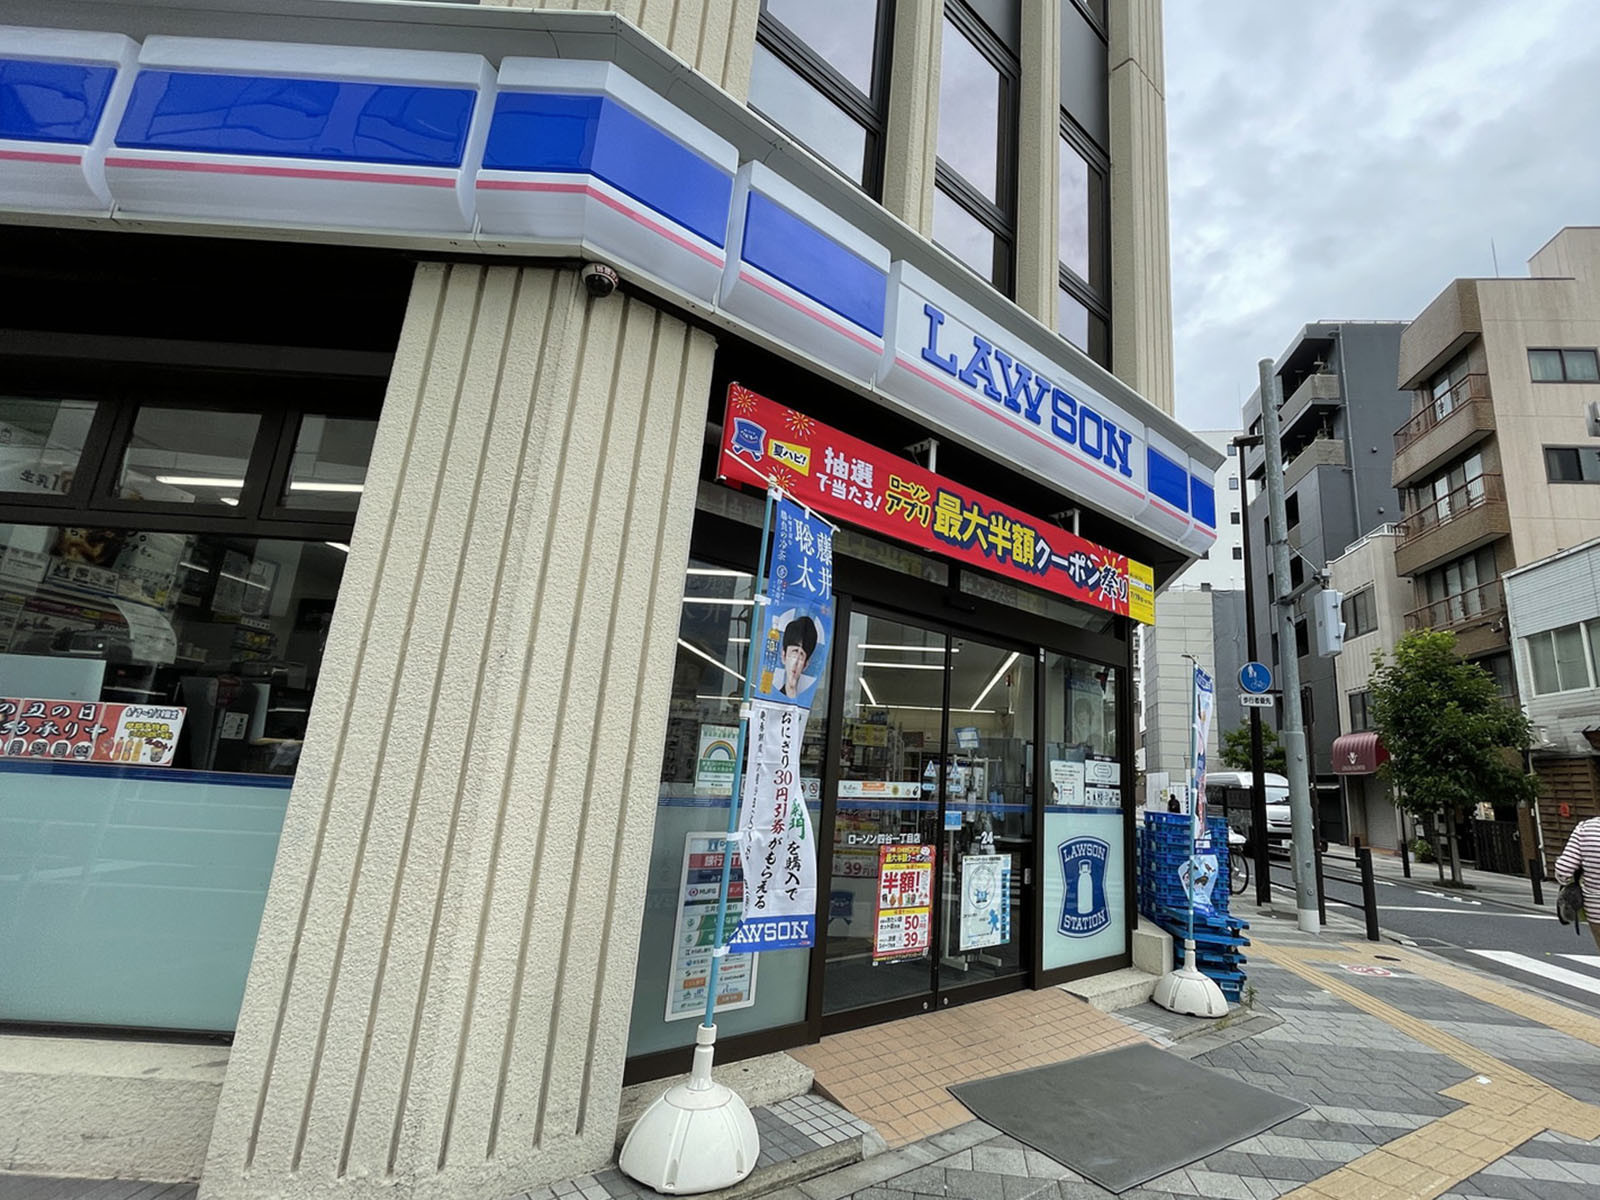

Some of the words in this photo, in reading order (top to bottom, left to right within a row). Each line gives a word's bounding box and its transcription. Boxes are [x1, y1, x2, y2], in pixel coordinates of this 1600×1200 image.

[921, 303, 1133, 478] LAWSON
[773, 442, 807, 467] 夏ハピ!
[824, 446, 874, 490] 抽選
[816, 472, 882, 512] で当たる!
[889, 475, 931, 500] ローソン
[886, 493, 931, 526] アプリ
[790, 518, 817, 592] 聡太
[816, 532, 832, 600] 藤井
[754, 711, 793, 910] おにぎり30円引券がもらえる
[848, 833, 921, 845] ローソン四谷一丁目店
[1063, 843, 1106, 862] LAWSON
[882, 871, 920, 895] 半額!
[904, 915, 919, 930] 50
[1063, 909, 1106, 930] STATION
[903, 932, 918, 947] 39
